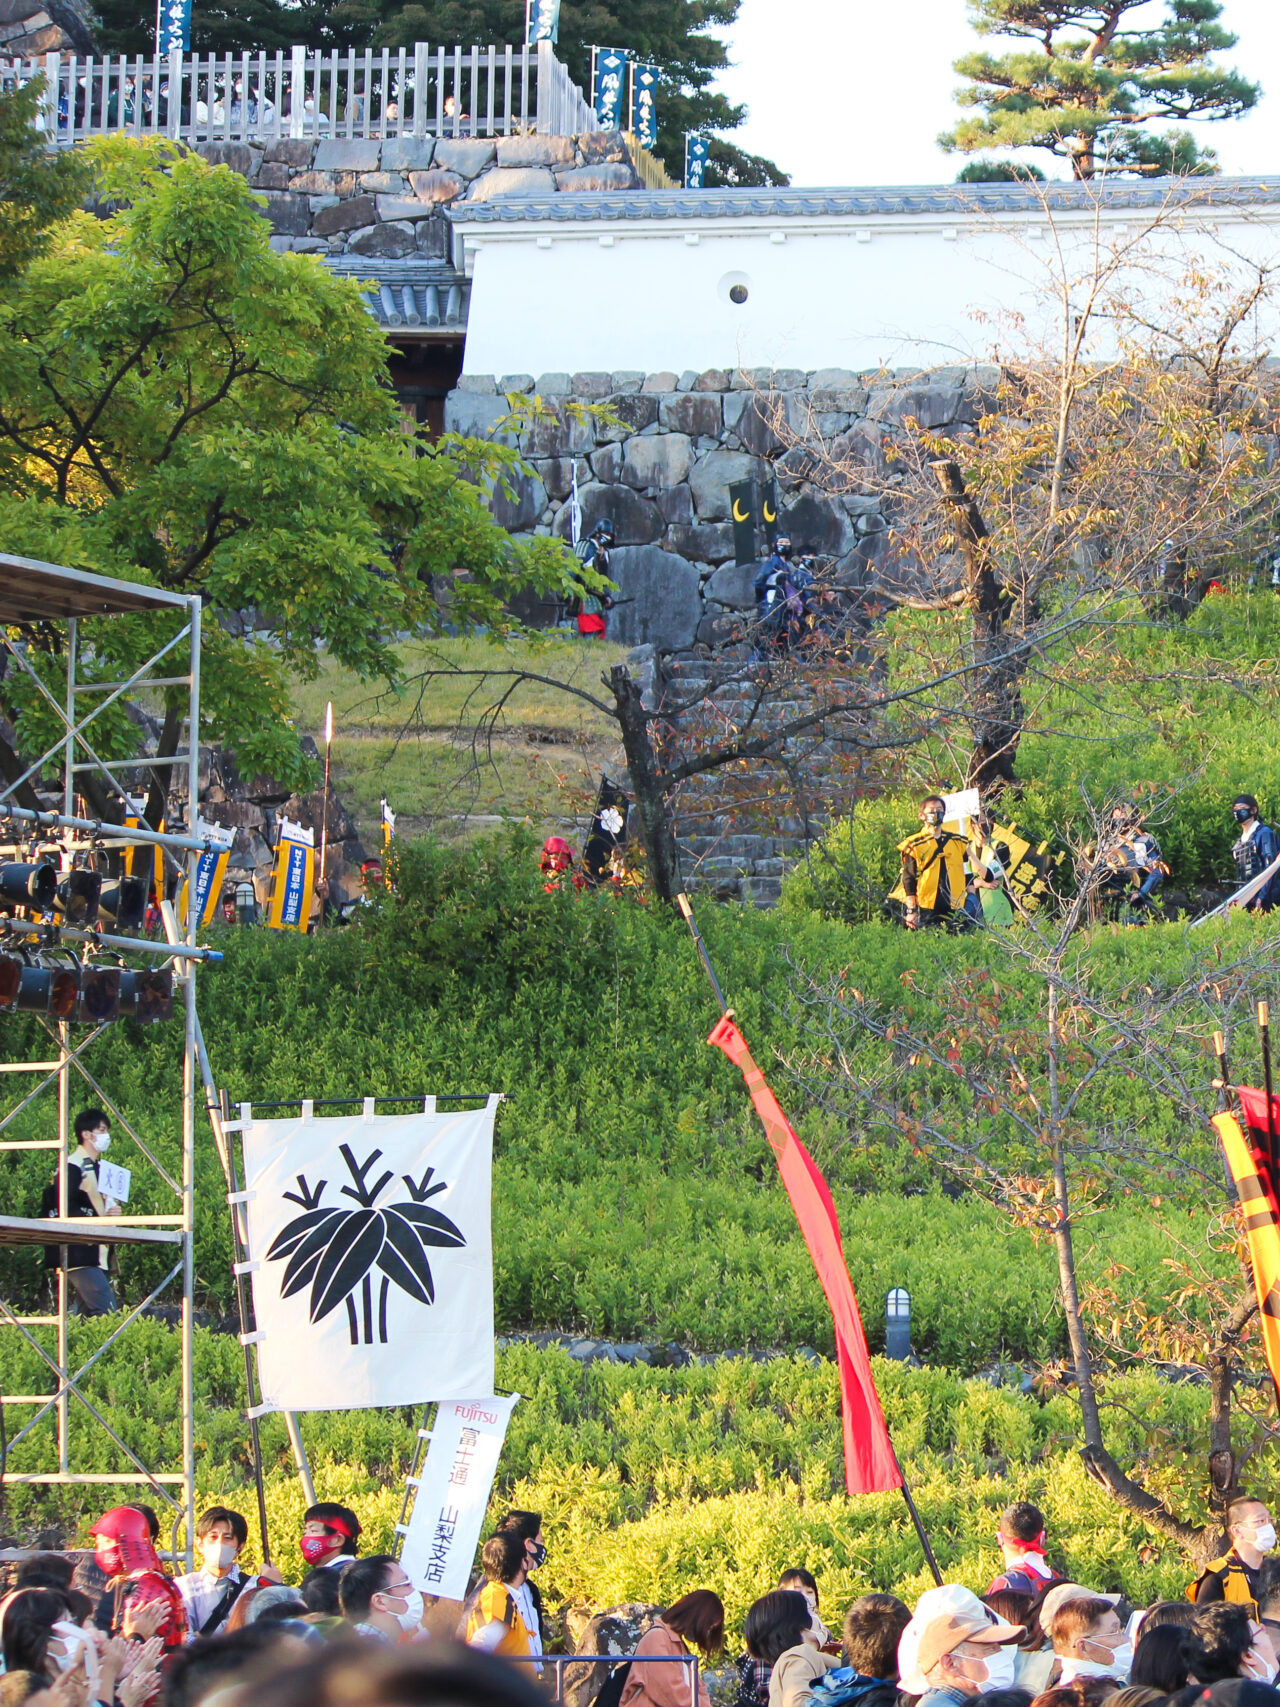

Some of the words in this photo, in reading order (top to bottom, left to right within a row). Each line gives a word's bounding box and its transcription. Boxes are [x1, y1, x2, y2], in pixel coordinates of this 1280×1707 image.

[168, 0, 186, 49] 林火山
[290, 849, 303, 890] NTT東日本
[284, 892, 299, 923] 山梨支店
[454, 1405, 498, 1425] FUJITSU
[447, 1426, 481, 1486] 富士通
[424, 1504, 459, 1584] 山梨支店
